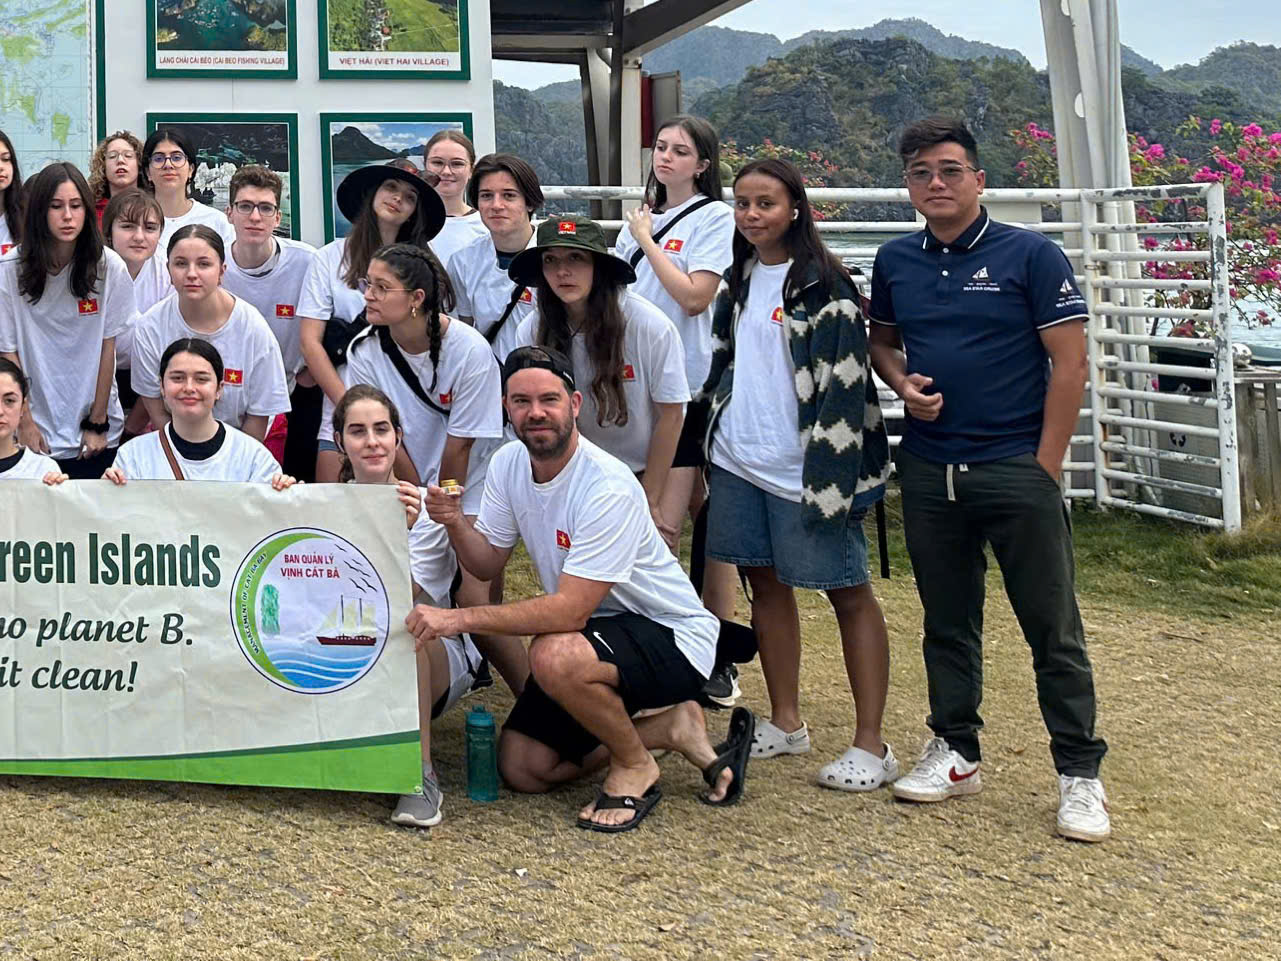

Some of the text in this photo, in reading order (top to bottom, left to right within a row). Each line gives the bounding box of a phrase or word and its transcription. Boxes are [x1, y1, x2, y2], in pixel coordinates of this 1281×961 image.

[260, 58, 285, 66] VILLAGE)
[412, 58, 450, 66] VILLAGE)
[89, 532, 221, 588] Islands
[284, 554, 300, 563] BAN
[281, 567, 303, 580] VỊNH
[305, 566, 324, 578] CÁT
[36, 611, 150, 647] planet
[160, 613, 193, 646] B.
[31, 659, 138, 692] clean!
